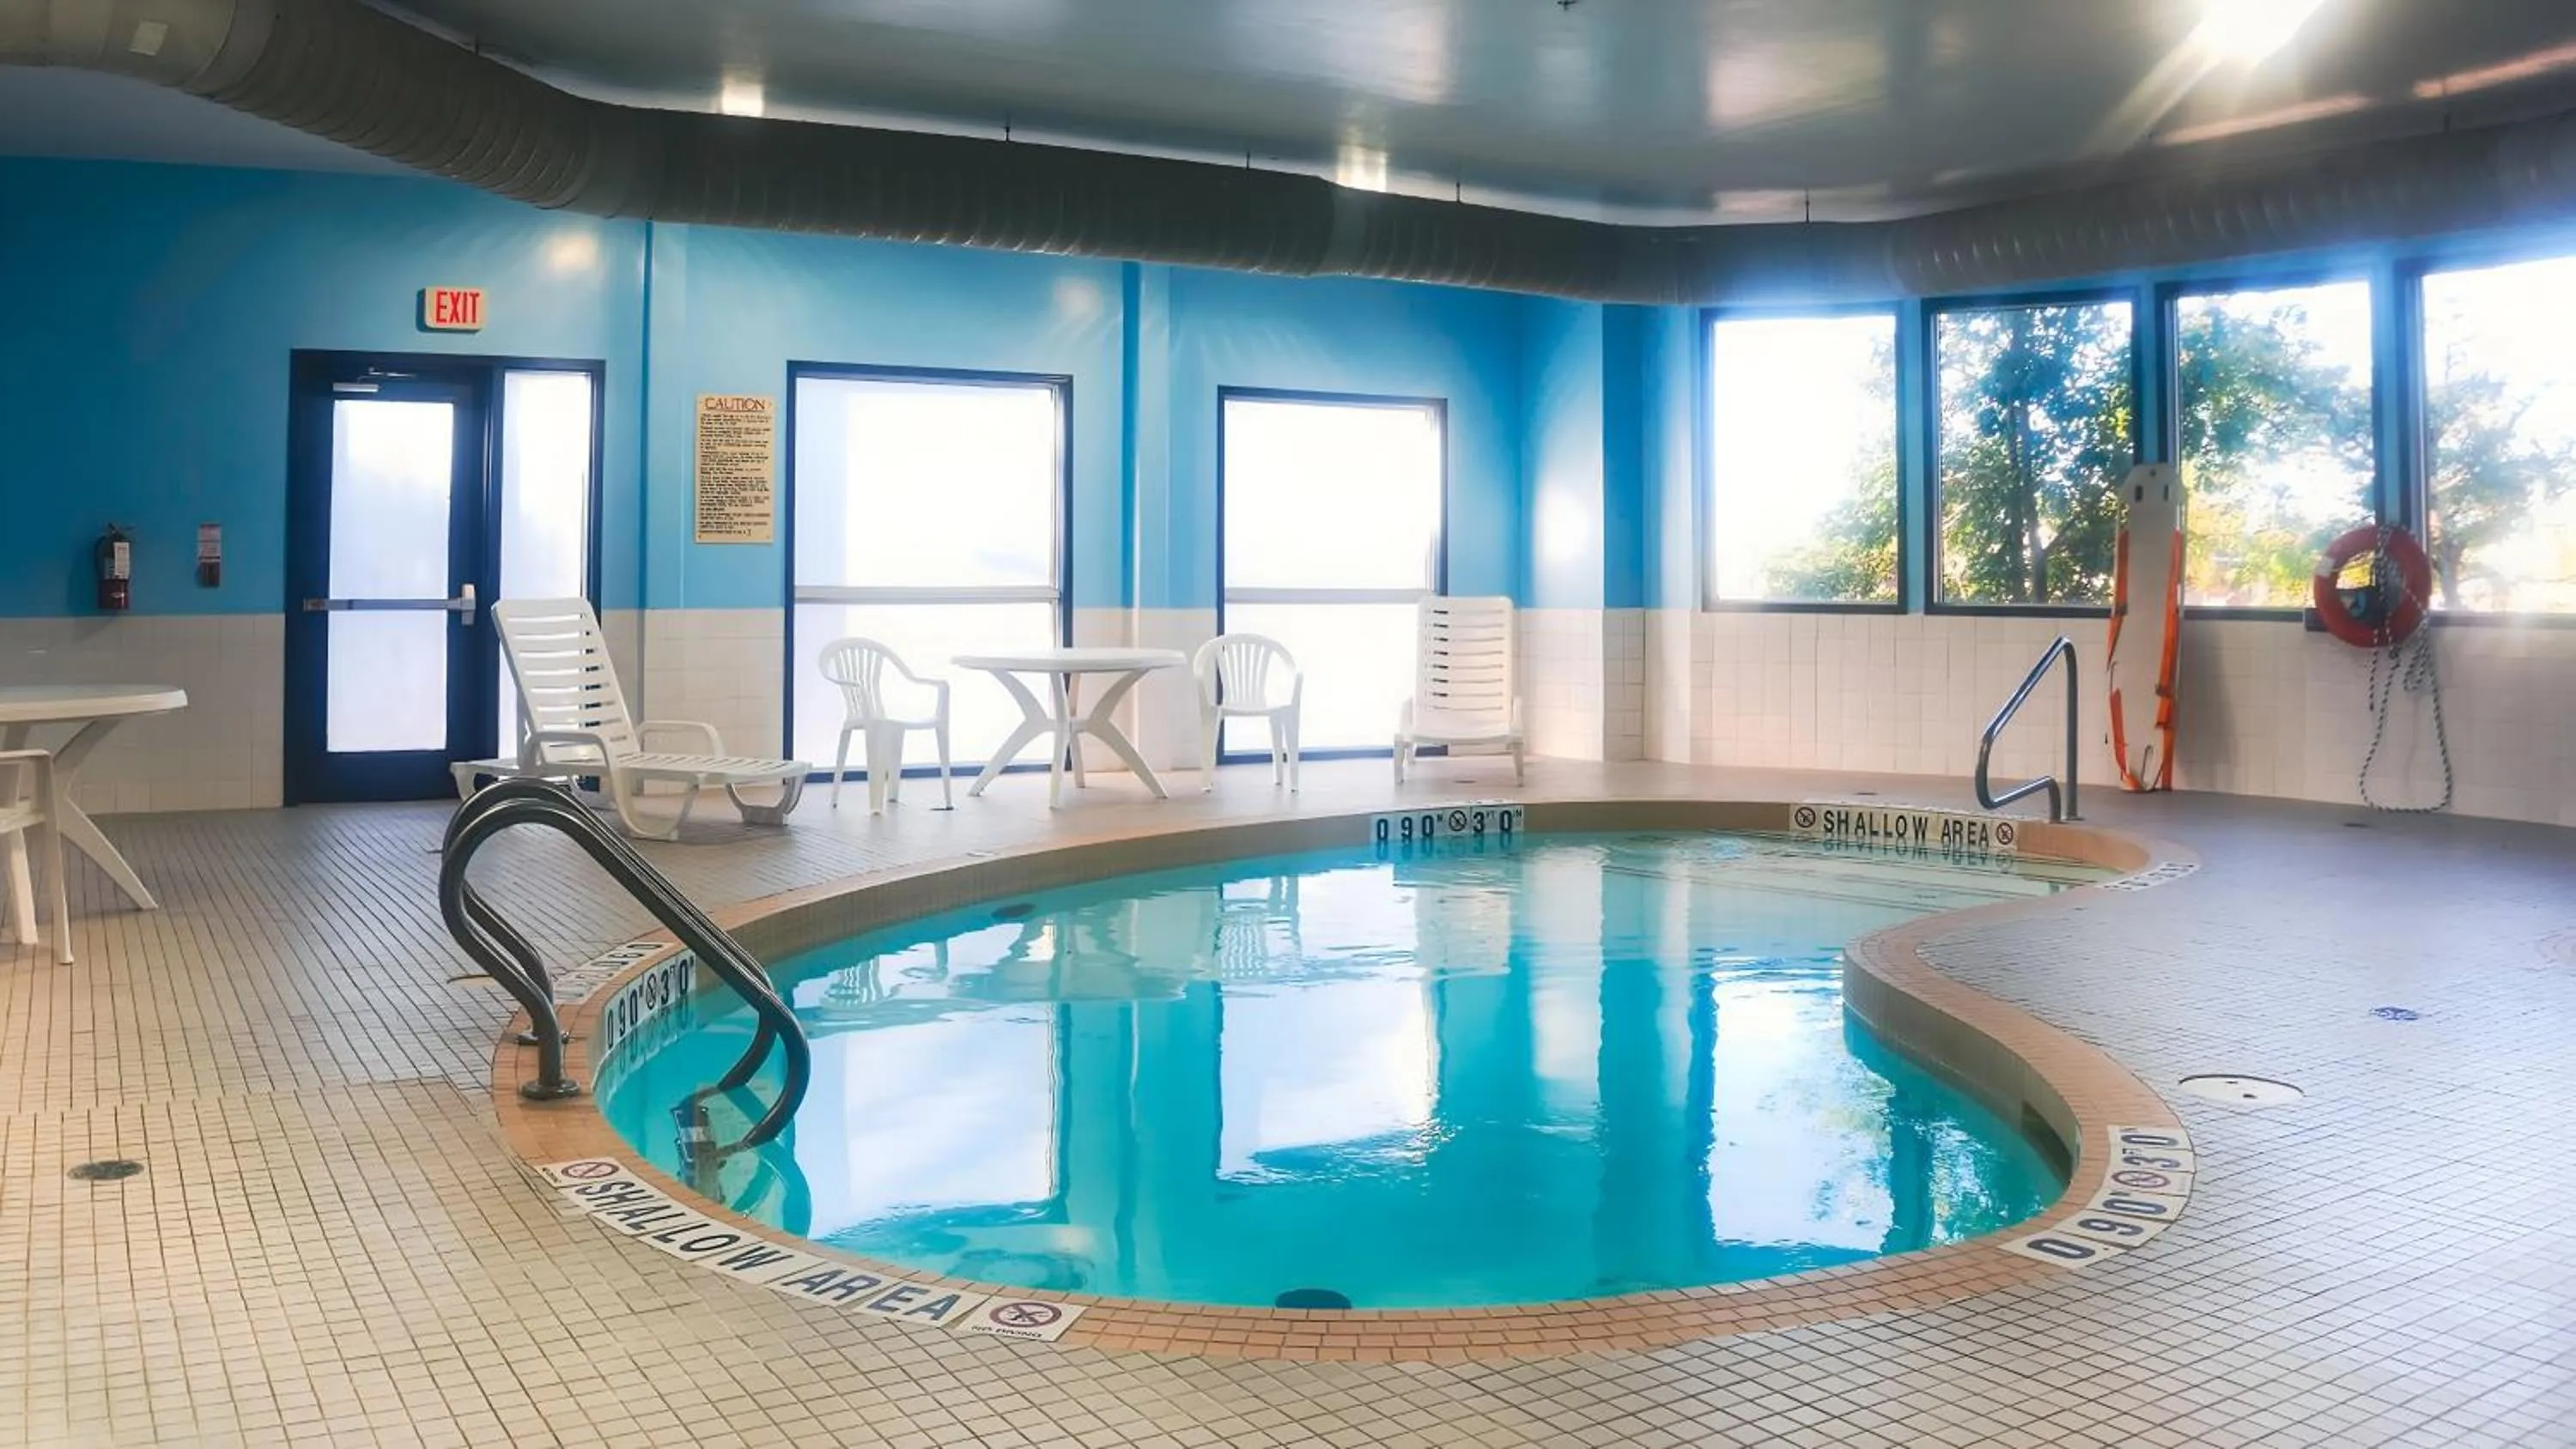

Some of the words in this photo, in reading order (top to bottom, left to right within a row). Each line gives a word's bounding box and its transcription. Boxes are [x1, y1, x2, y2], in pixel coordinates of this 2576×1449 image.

[435, 291, 480, 324] EXIT
[705, 397, 766, 410] CAUTION
[1823, 809, 1928, 840] SHALLOW
[1941, 818, 1990, 846] AREA
[574, 1180, 793, 1271] SHALLOW
[781, 1269, 961, 1321] AREA
